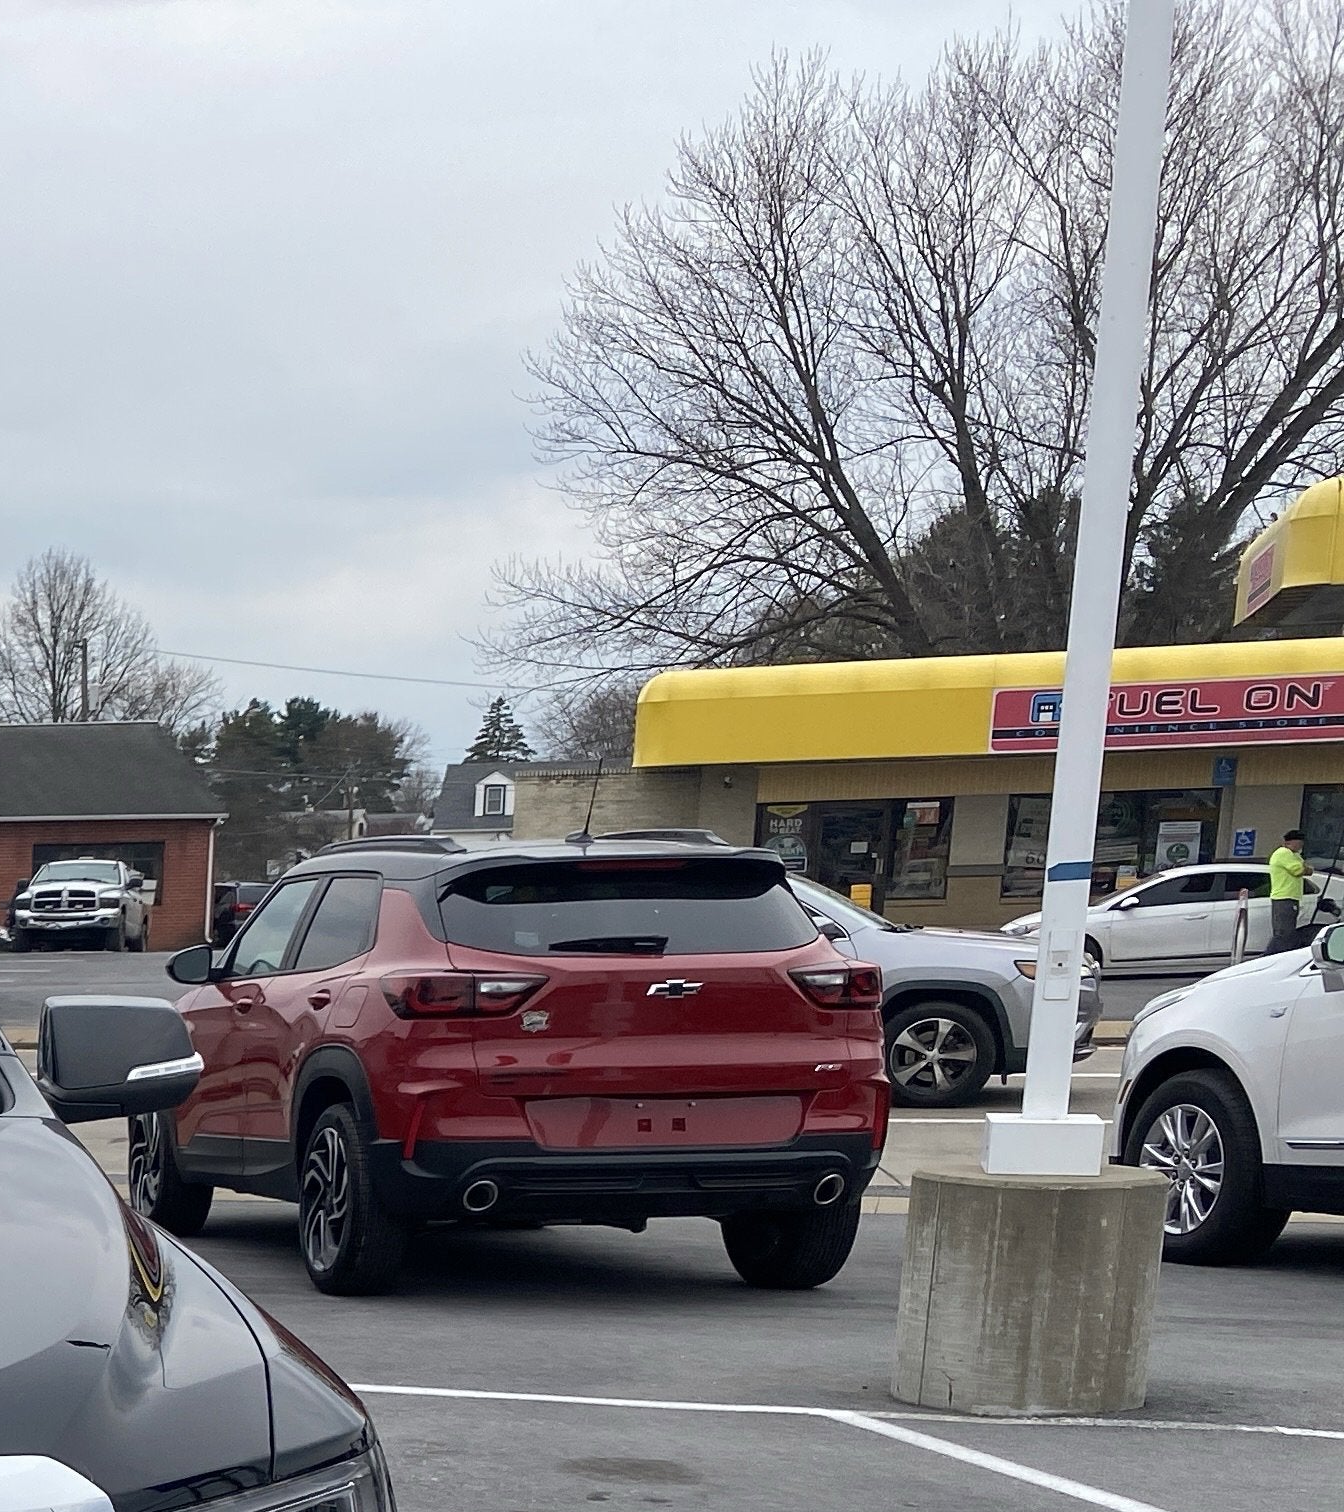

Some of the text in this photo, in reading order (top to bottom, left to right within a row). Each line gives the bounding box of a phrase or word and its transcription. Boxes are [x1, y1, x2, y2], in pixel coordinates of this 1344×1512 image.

[1109, 681, 1323, 719] UEL ON
[1016, 717, 1327, 737] CONIENCE STORE
